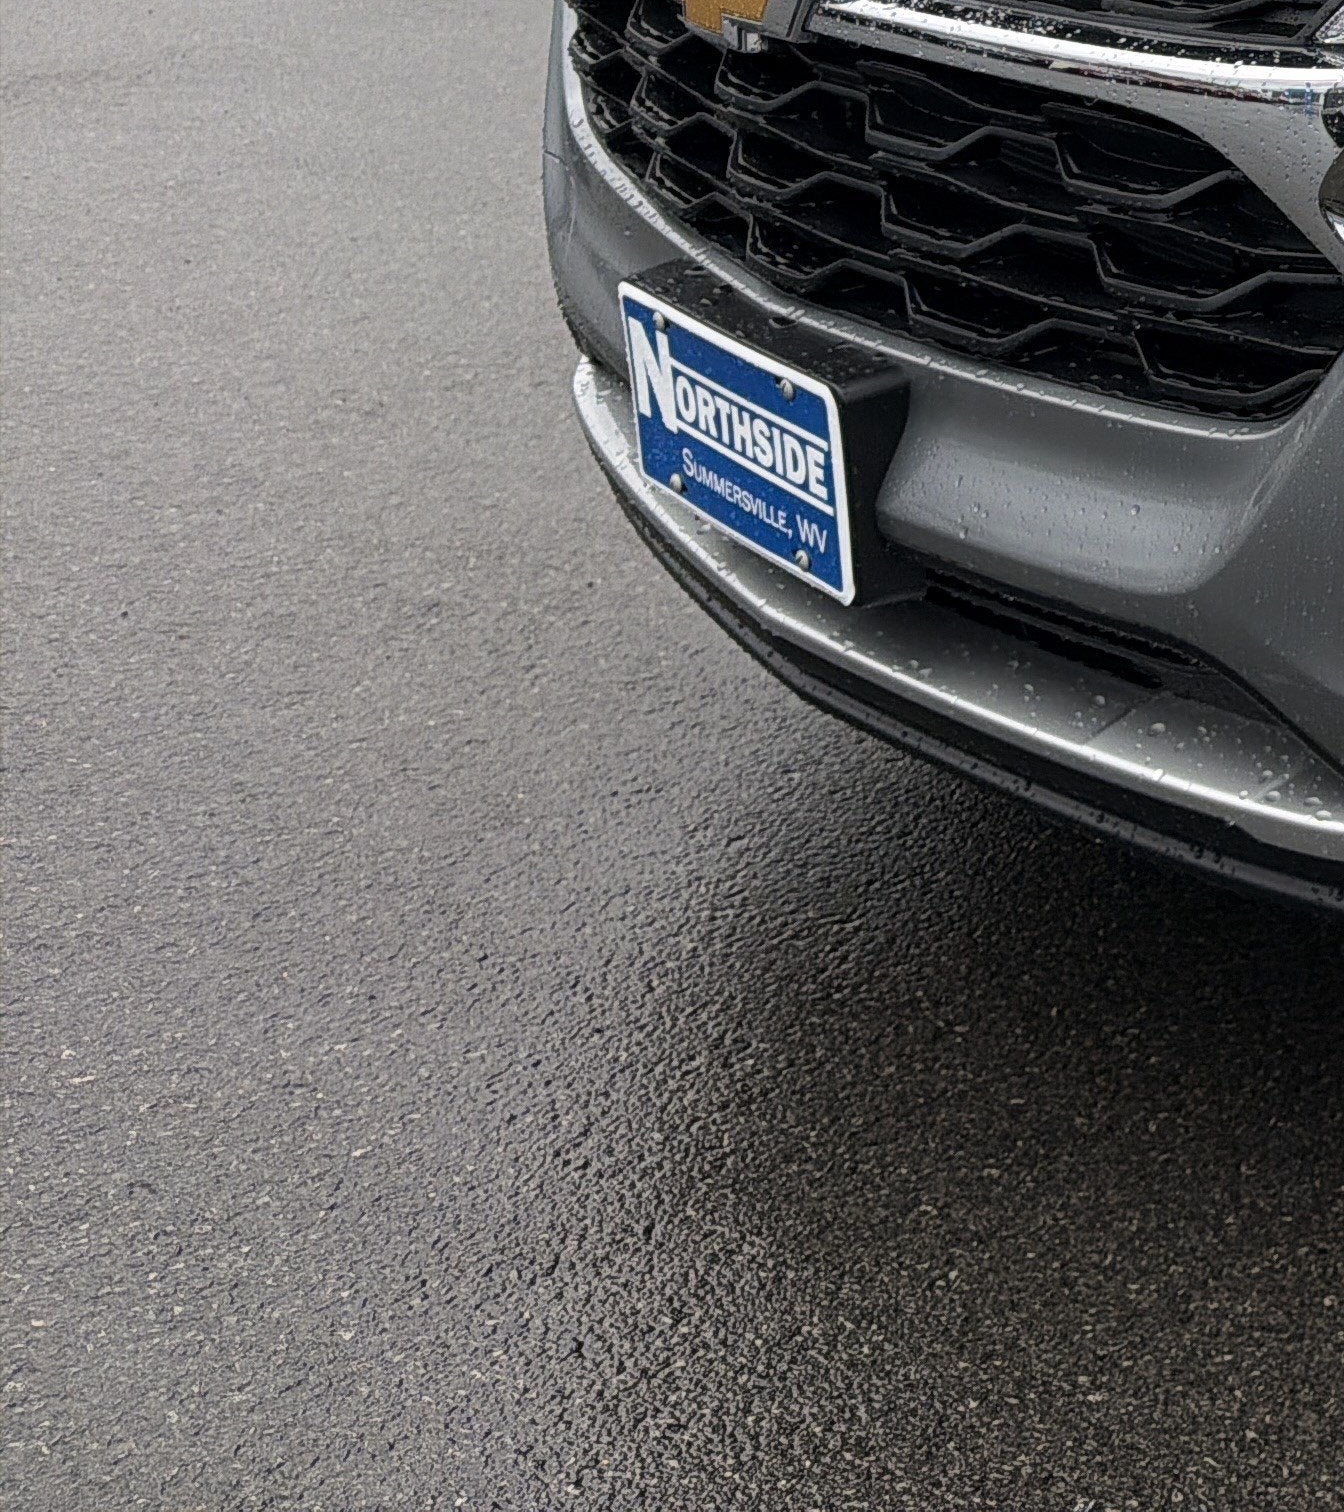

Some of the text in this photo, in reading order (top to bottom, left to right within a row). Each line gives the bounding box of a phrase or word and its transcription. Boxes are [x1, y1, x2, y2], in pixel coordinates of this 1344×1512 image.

[627, 315, 829, 500] NORTHSIDE
[681, 447, 828, 554] SUMMERSVILLE, WV
